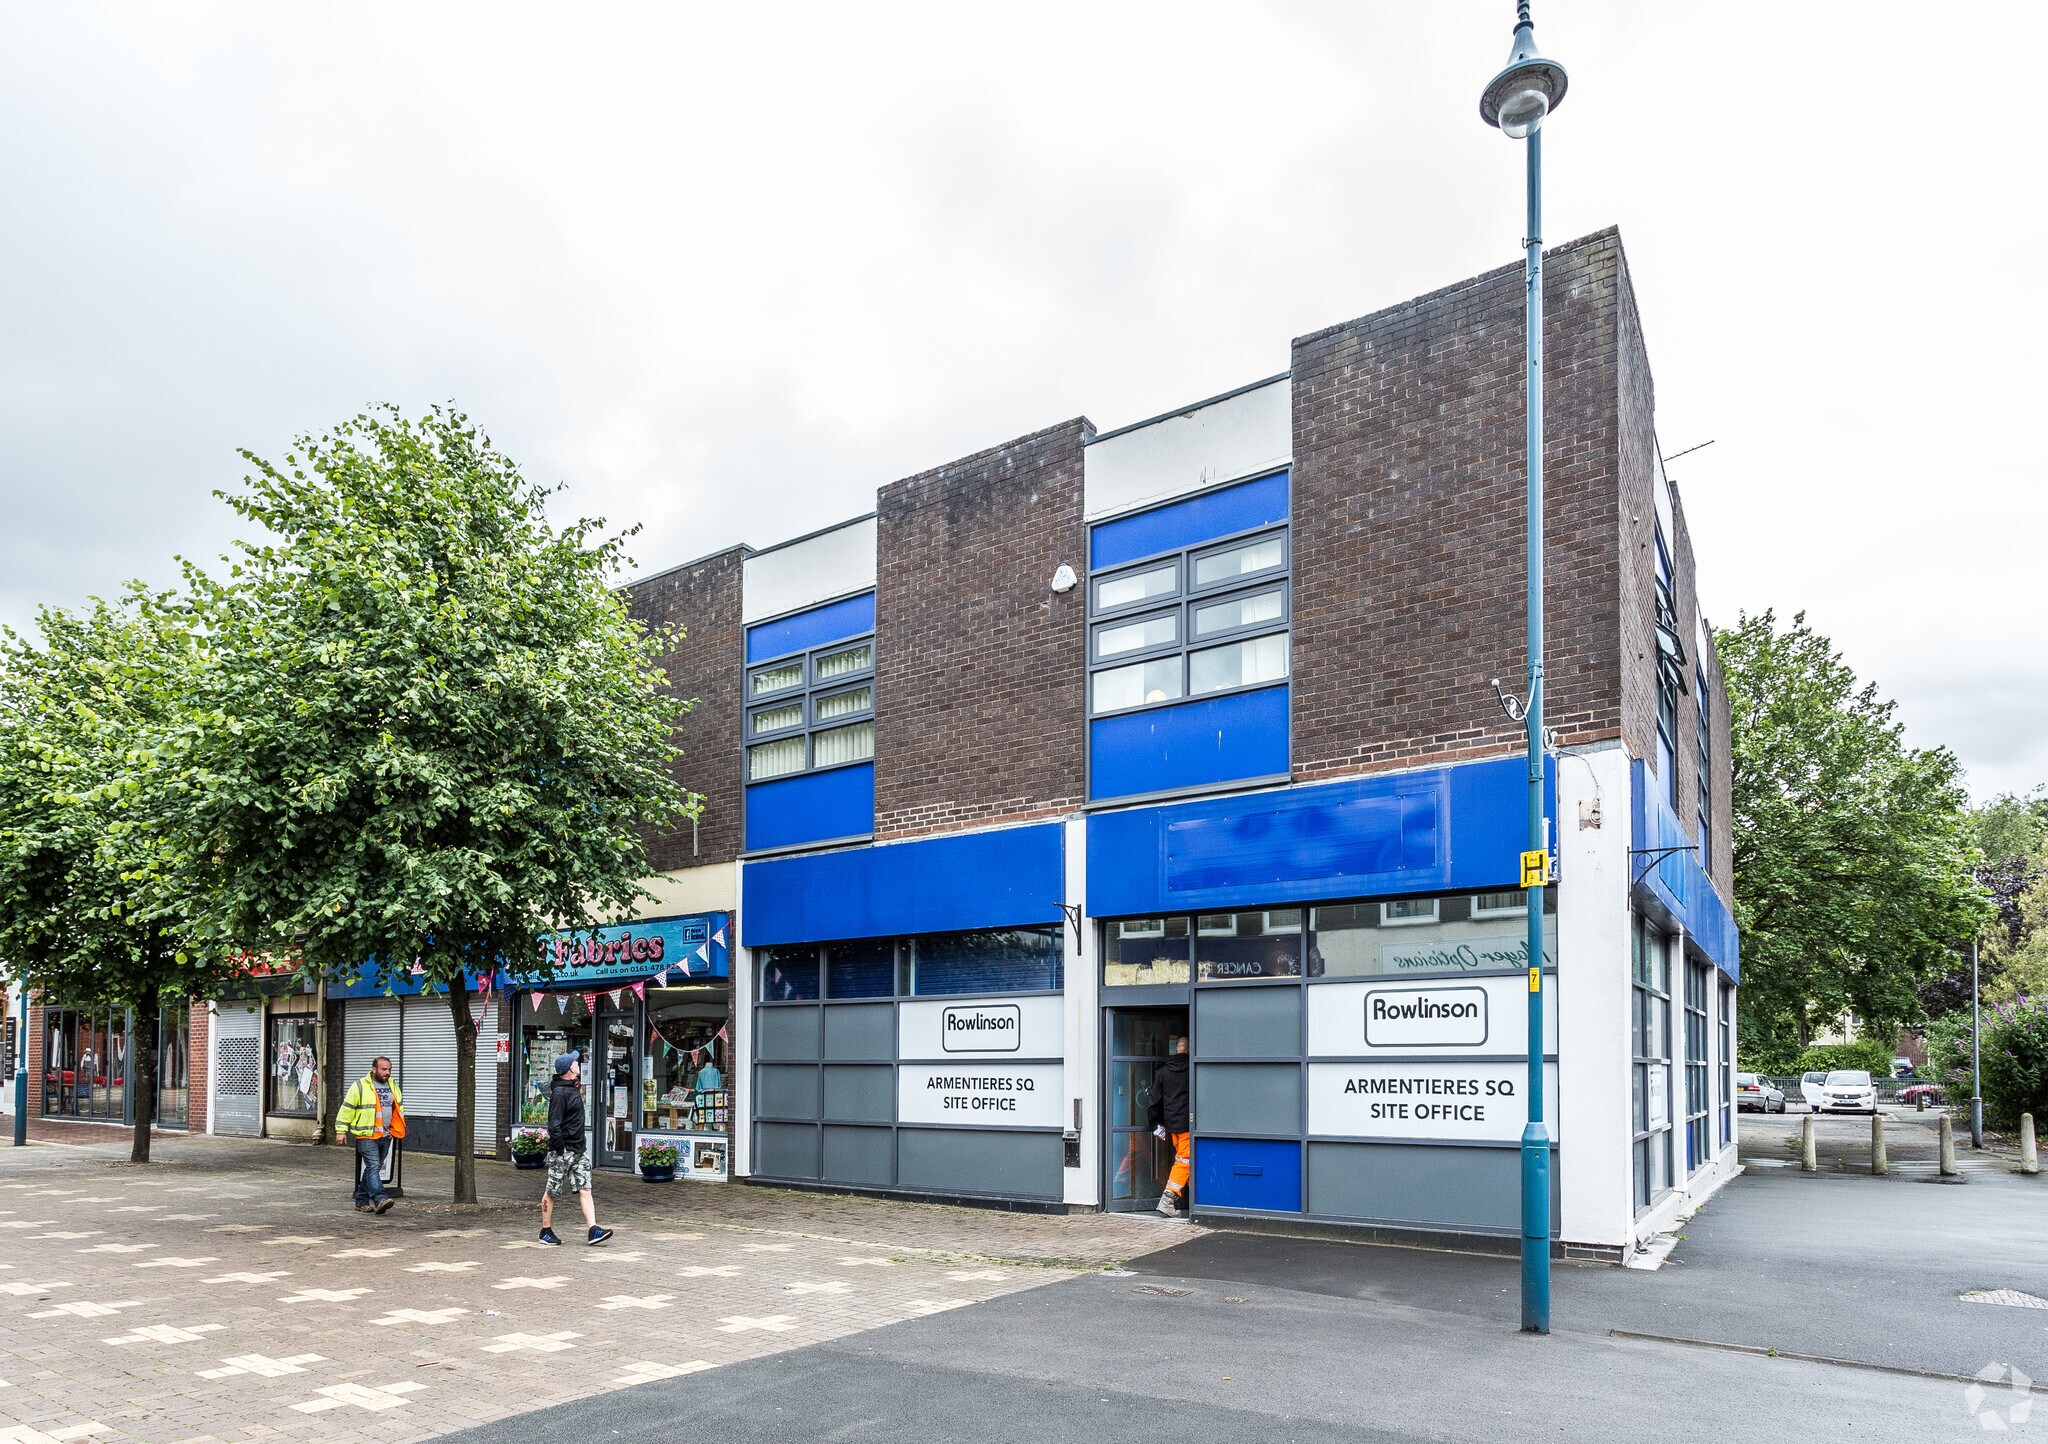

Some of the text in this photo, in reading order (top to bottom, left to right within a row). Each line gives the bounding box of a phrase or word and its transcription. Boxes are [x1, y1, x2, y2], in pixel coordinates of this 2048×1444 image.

[553, 931, 664, 968] Fabrics
[630, 965, 649, 973] 0161
[1531, 973, 1538, 983] 7
[1373, 996, 1478, 1020] Rowlinson
[947, 1012, 1015, 1031] Rowlinson
[926, 1076, 1035, 1091] ARMENTIERES SQ
[1343, 1078, 1515, 1096] ARMENTIERES SQ
[943, 1096, 1016, 1111] SITE OFFICE
[1370, 1102, 1485, 1122] SITE OFFICE
